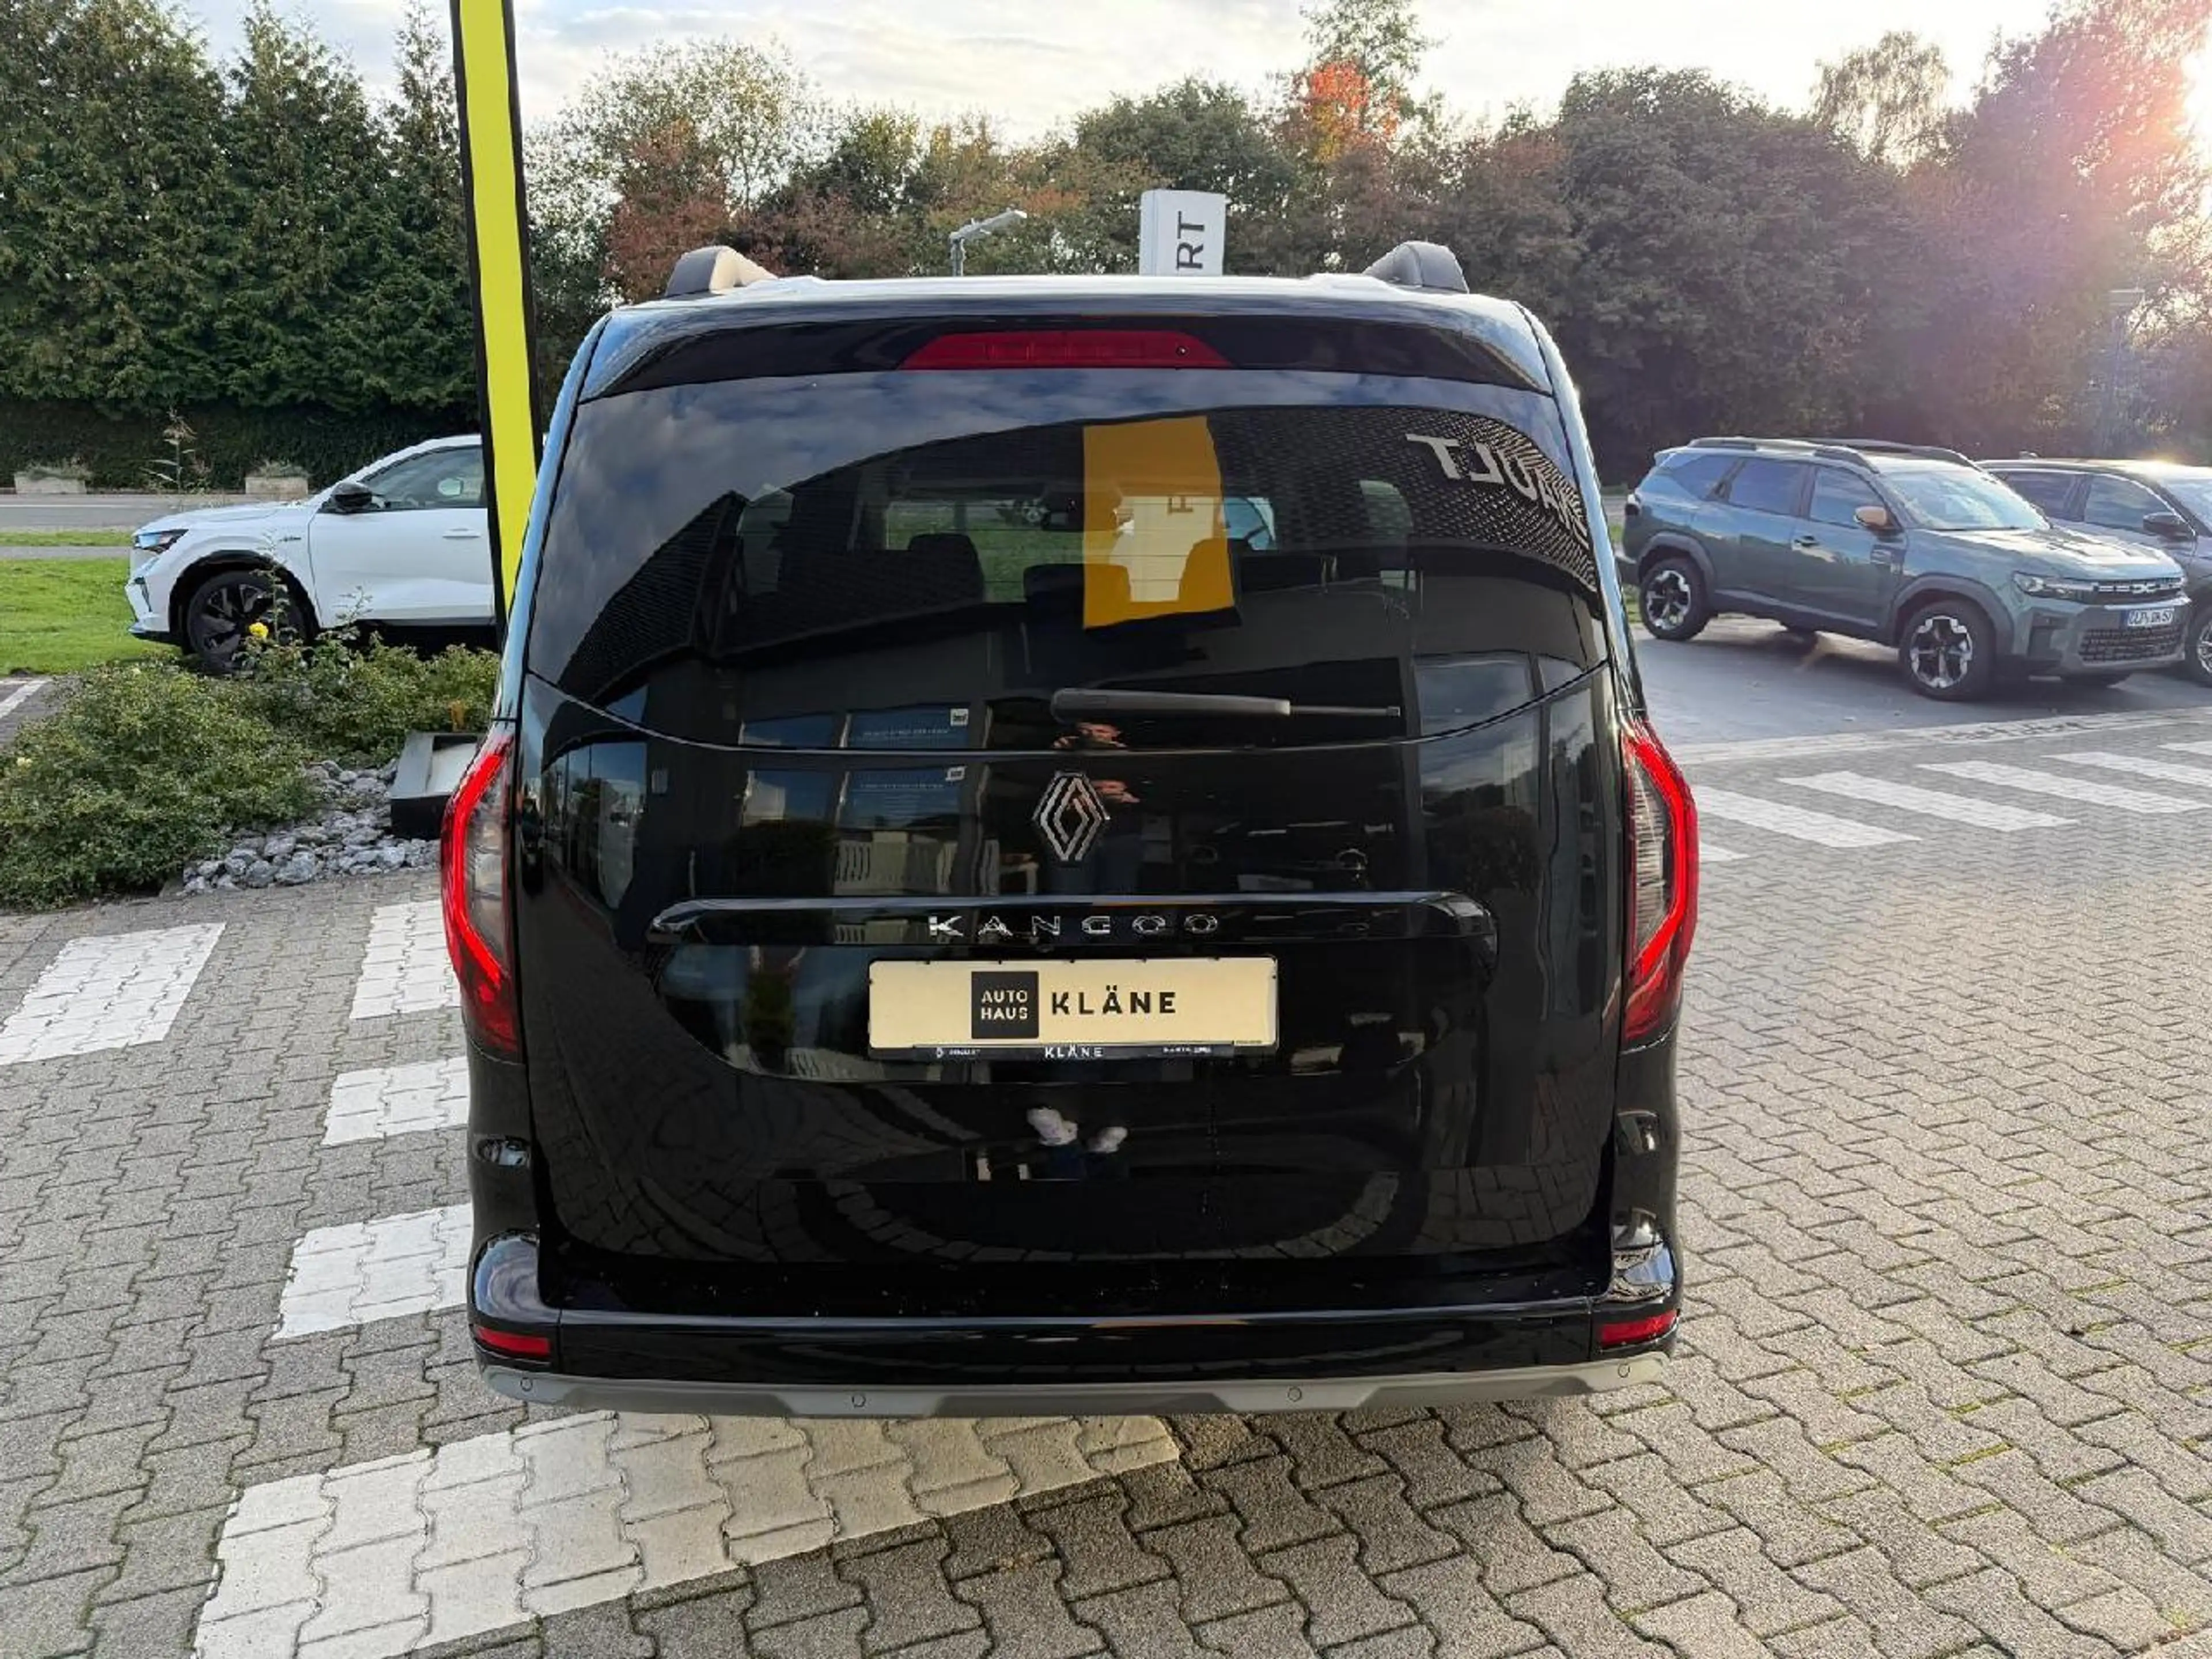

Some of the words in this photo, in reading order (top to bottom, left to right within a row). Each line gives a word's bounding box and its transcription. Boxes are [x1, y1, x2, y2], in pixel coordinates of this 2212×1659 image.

[1177, 211, 1205, 270] RT
[928, 914, 1218, 937] KANGOO
[982, 990, 1028, 1003] AUTO
[1052, 984, 1176, 1015] KLÄNE
[981, 1006, 1028, 1020] HAUS
